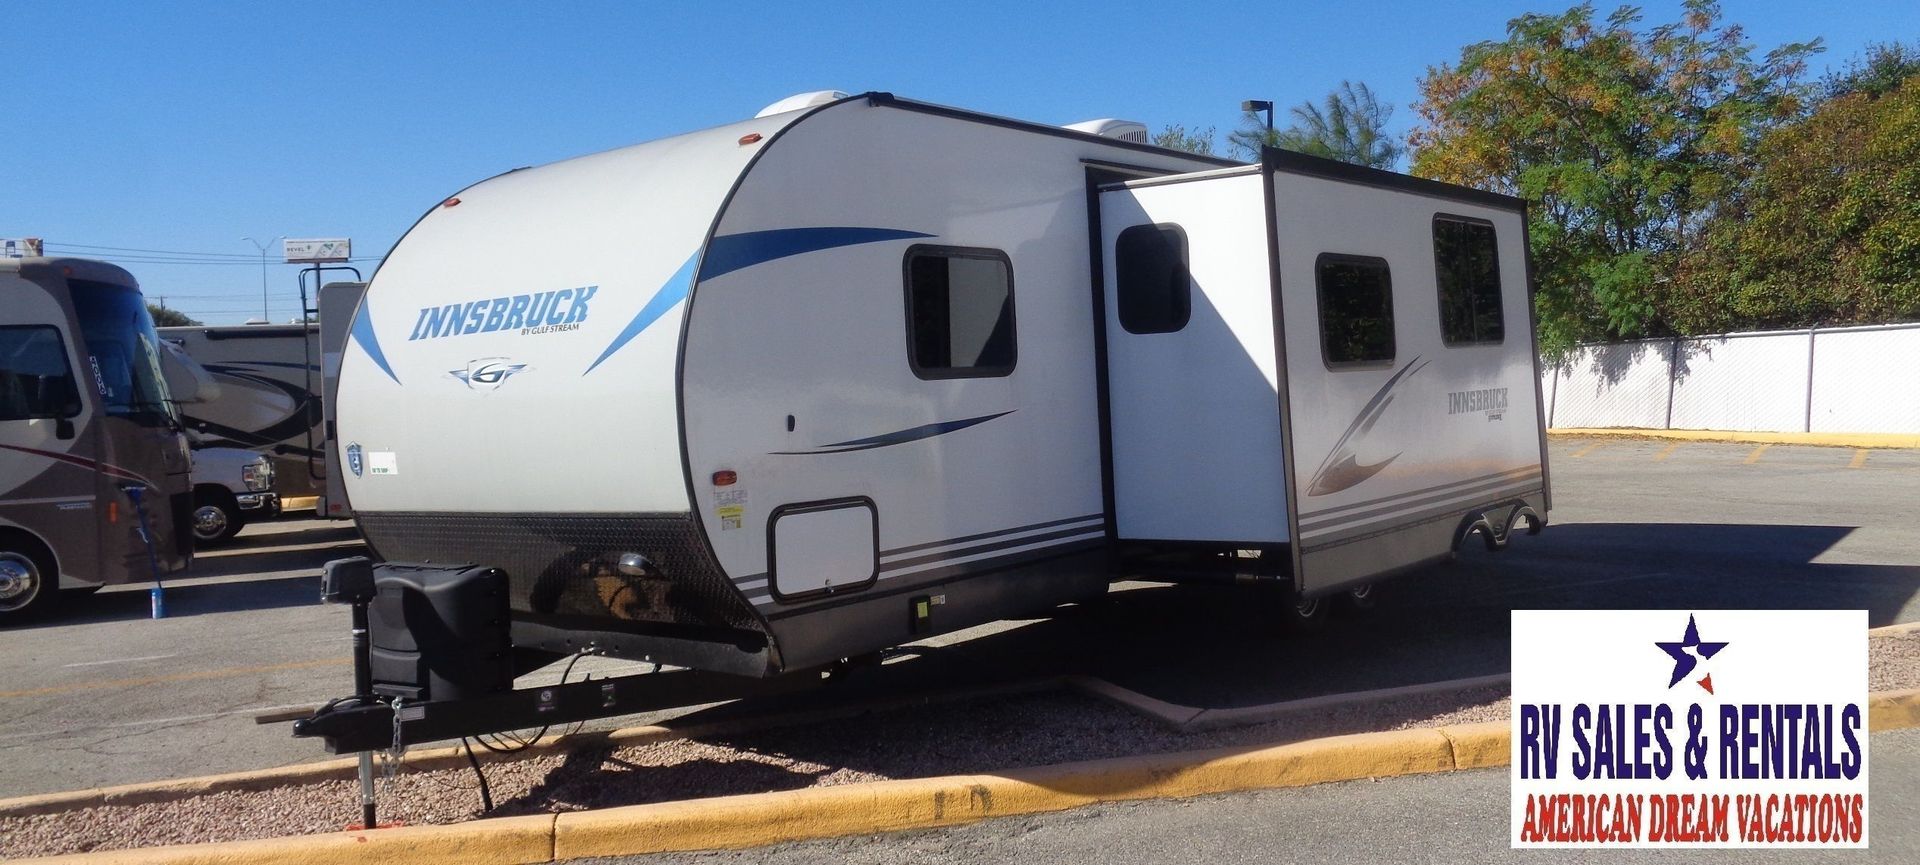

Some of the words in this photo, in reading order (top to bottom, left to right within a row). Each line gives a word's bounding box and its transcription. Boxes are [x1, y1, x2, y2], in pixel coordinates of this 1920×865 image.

[408, 286, 598, 341] INNSBRUCK
[521, 328, 530, 336] BY
[531, 325, 550, 335] GULF
[549, 323, 580, 333] STREAM
[1448, 387, 1508, 415] INNSBRUCK
